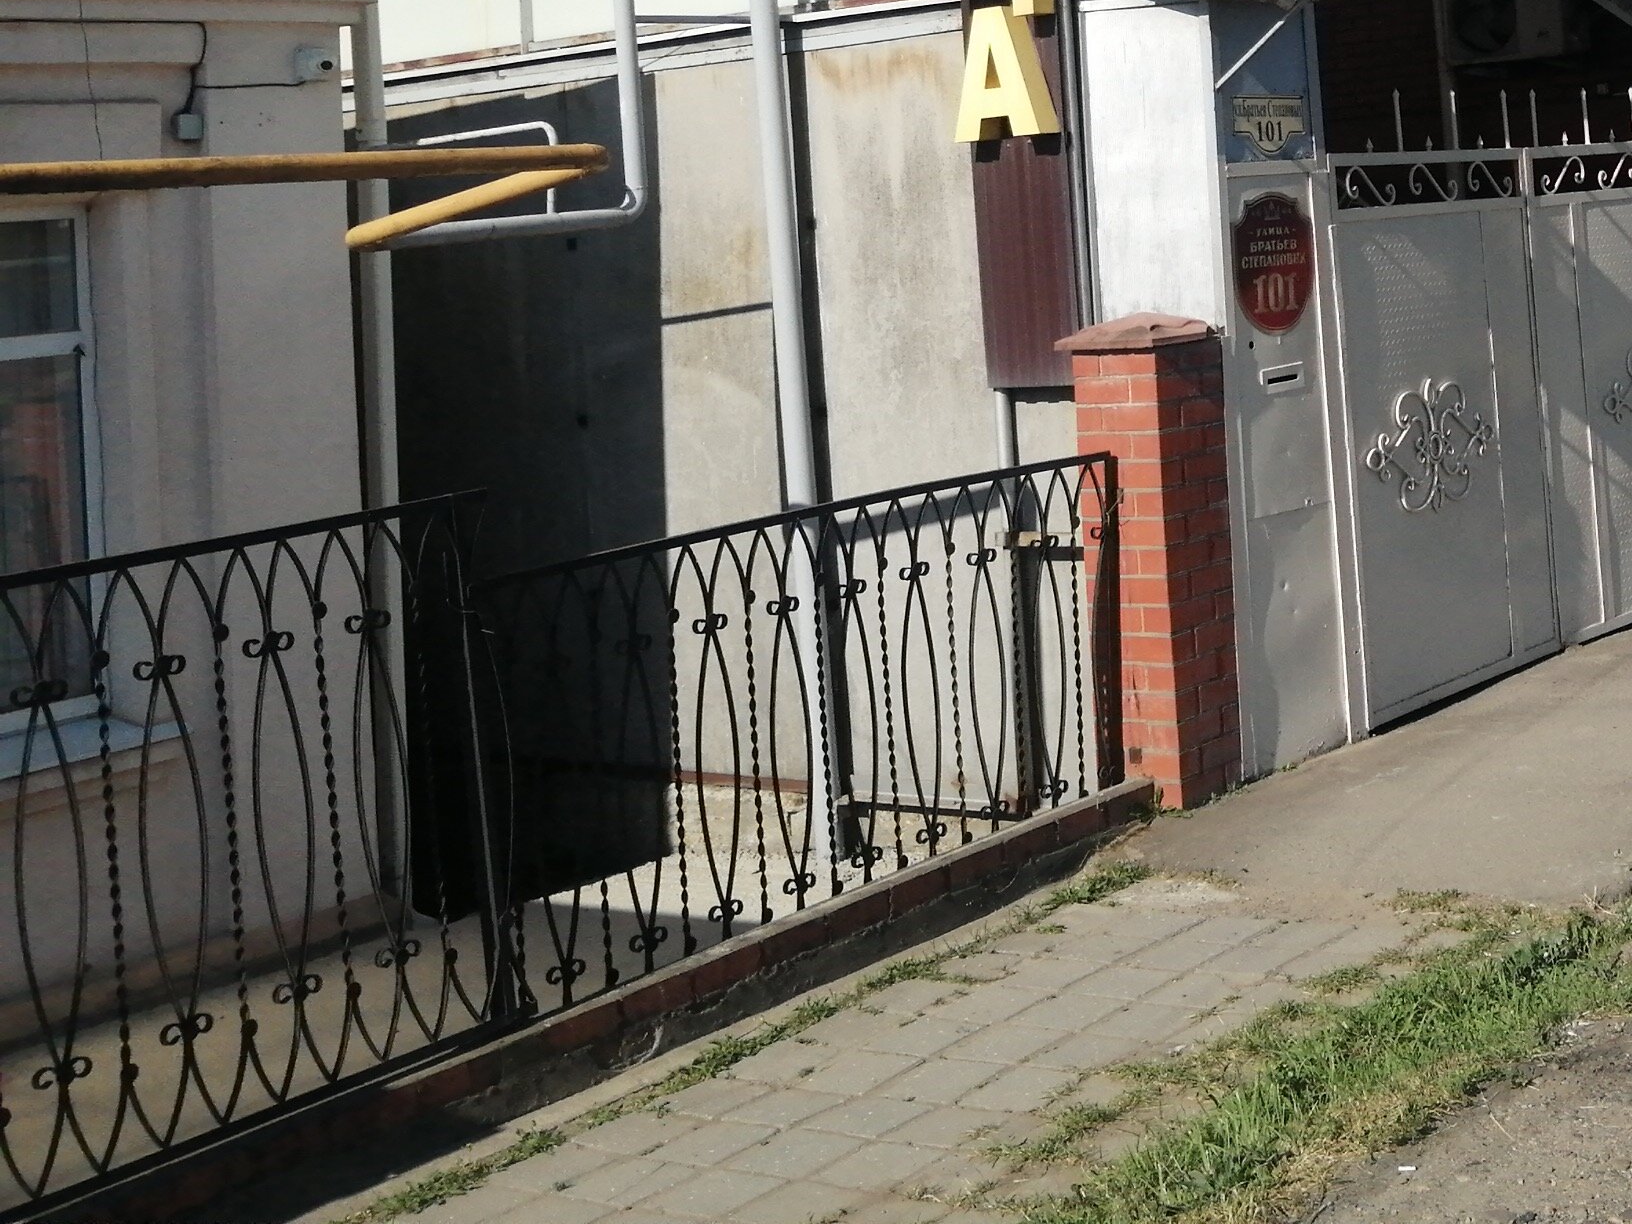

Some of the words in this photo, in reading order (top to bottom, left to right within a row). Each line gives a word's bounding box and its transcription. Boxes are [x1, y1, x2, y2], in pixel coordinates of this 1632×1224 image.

[1256, 120, 1284, 142] 101
[1256, 226, 1290, 237] УЛИЦА
[1250, 239, 1298, 254] БРАТЬЕВ
[1253, 272, 1299, 313] 101
